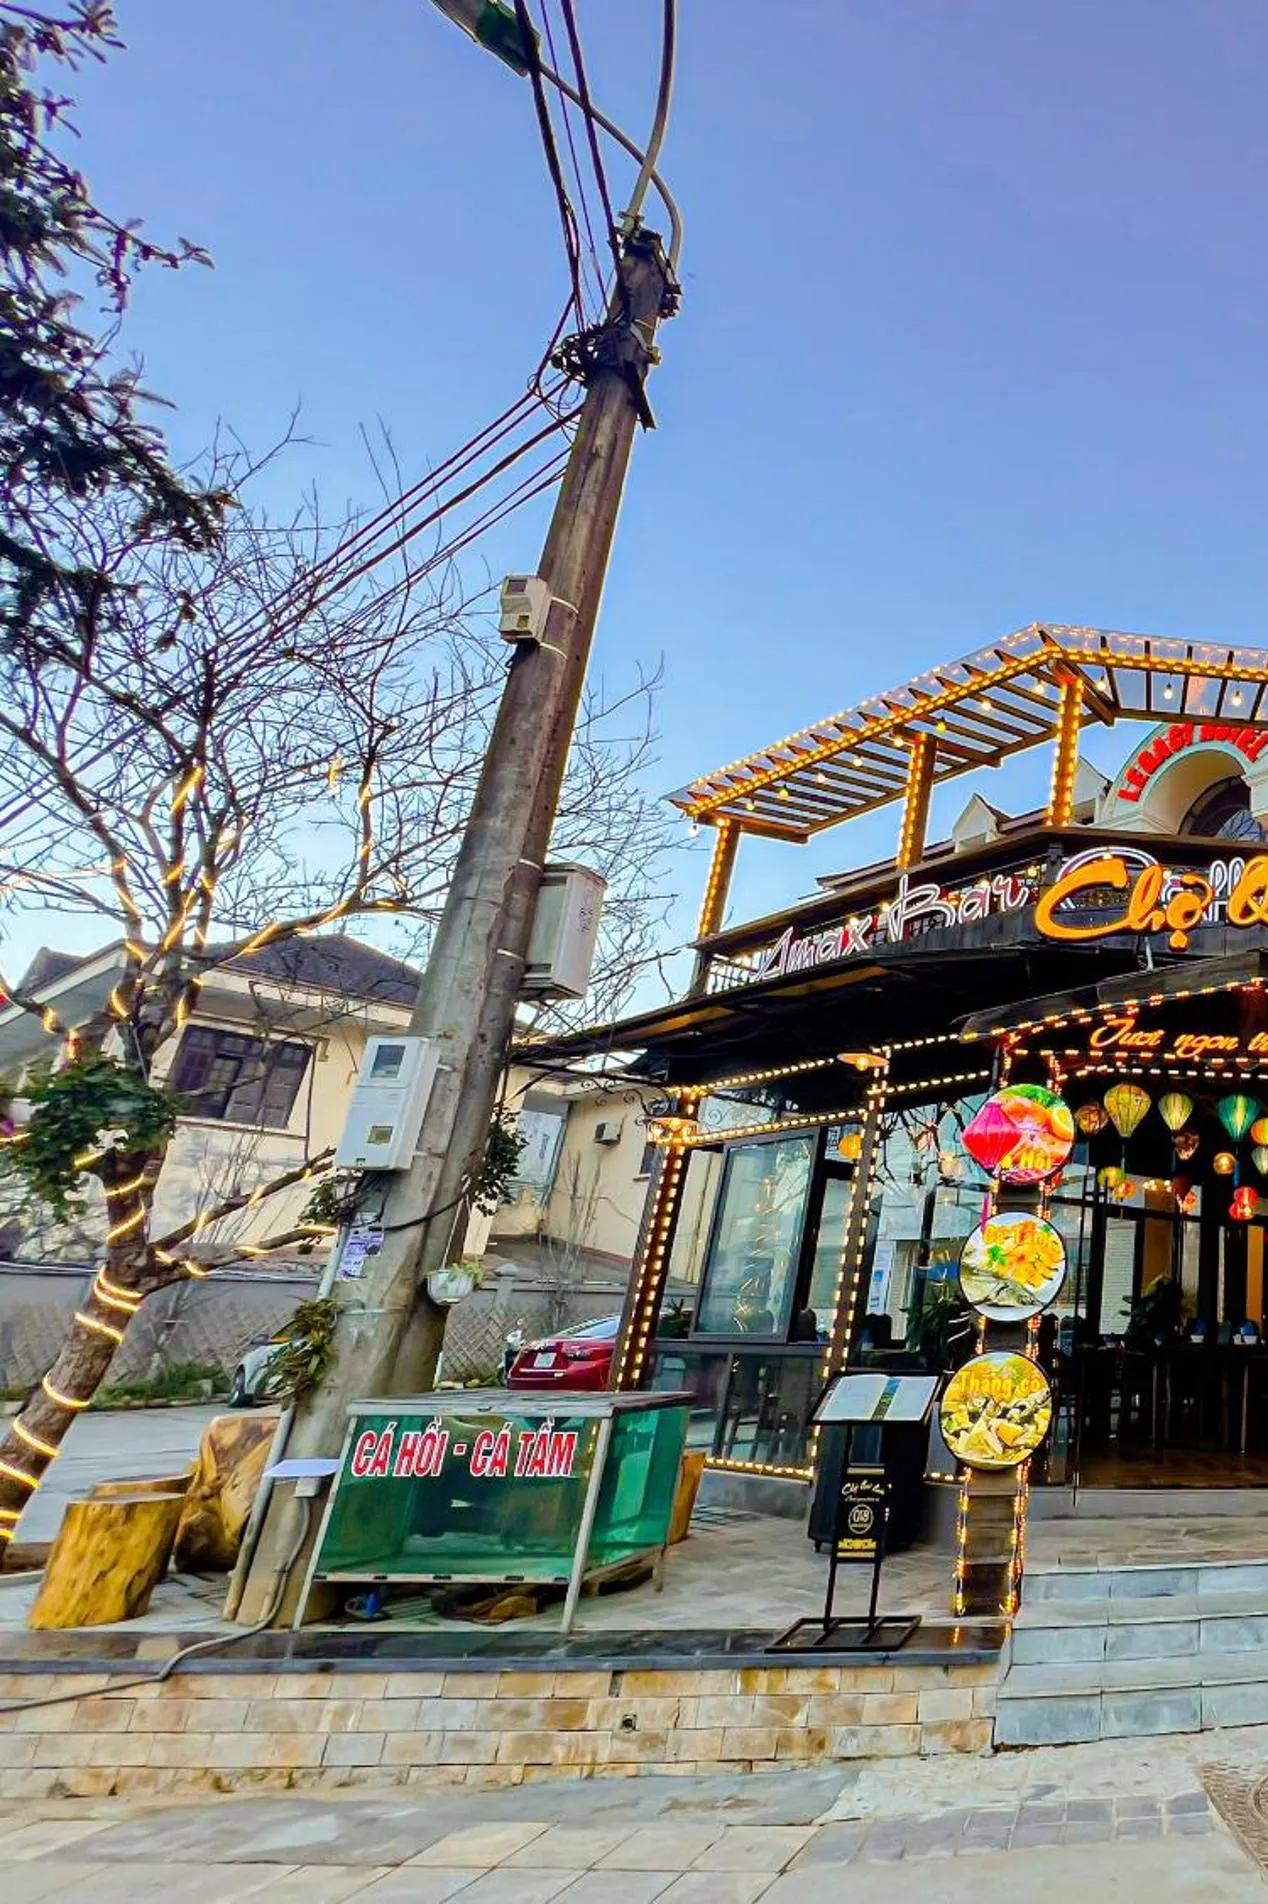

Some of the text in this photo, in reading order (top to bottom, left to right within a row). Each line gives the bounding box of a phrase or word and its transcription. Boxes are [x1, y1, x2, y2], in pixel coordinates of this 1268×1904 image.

[887, 873, 1030, 942] Bar
[1035, 857, 1214, 951] Chợ
[1174, 1034, 1239, 1058] ngon
[352, 1421, 398, 1476] CÁ
[392, 1416, 449, 1477] HỒI
[469, 1421, 513, 1477] CÁ
[514, 1416, 579, 1477] TẦM
